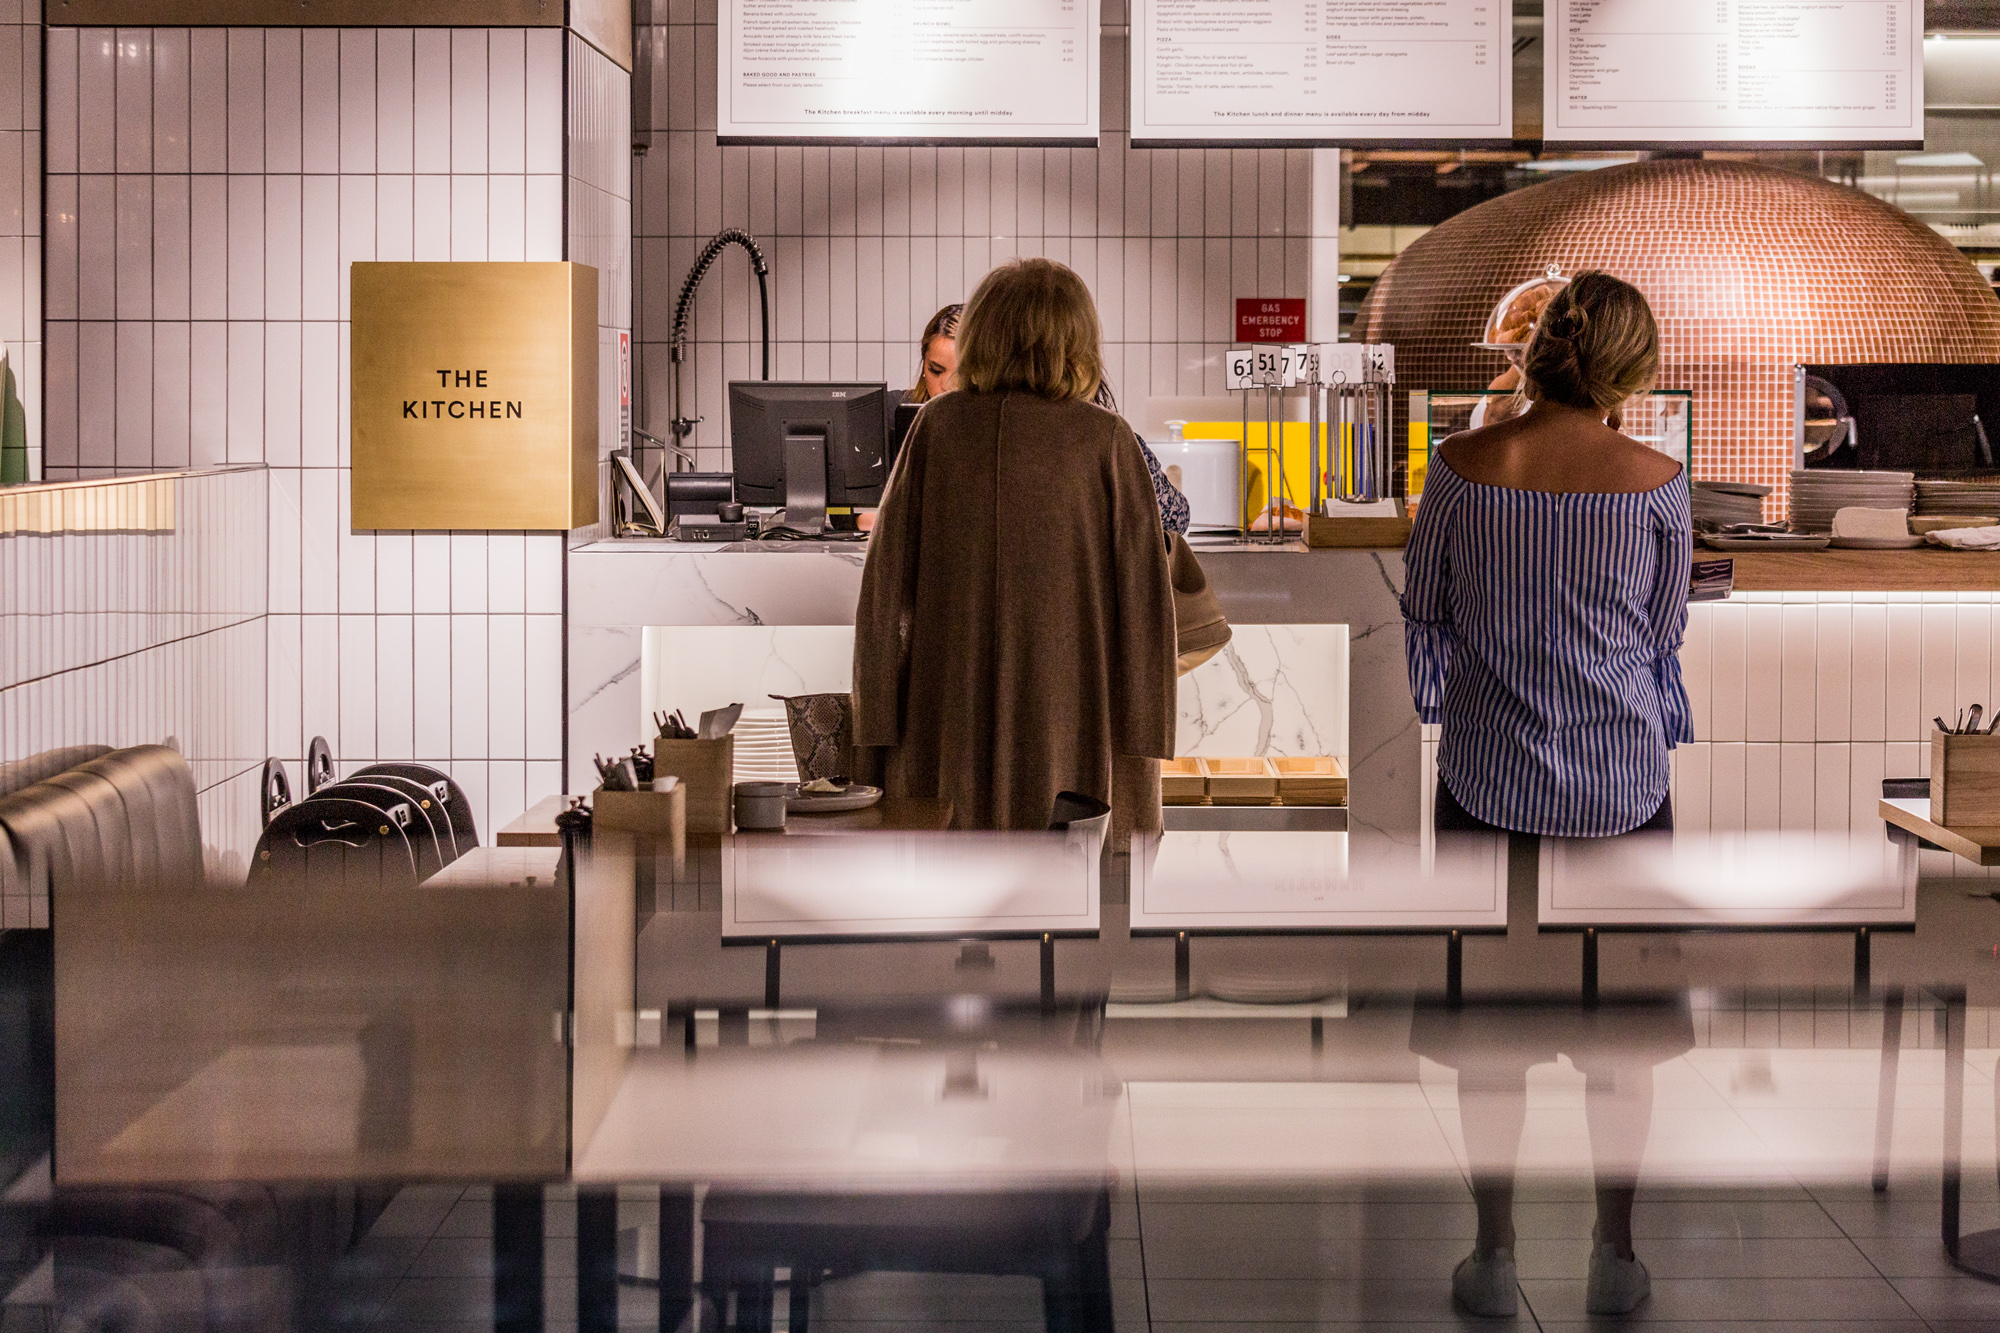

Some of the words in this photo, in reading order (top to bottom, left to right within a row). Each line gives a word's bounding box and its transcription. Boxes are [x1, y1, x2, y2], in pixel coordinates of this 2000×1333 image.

[1261, 304, 1280, 313] GAS
[1242, 316, 1300, 324] EMERGENCY
[1259, 328, 1283, 338] STOP
[1258, 353, 1276, 371] 51
[436, 370, 488, 388] THE
[403, 400, 522, 418] KITCHEN
